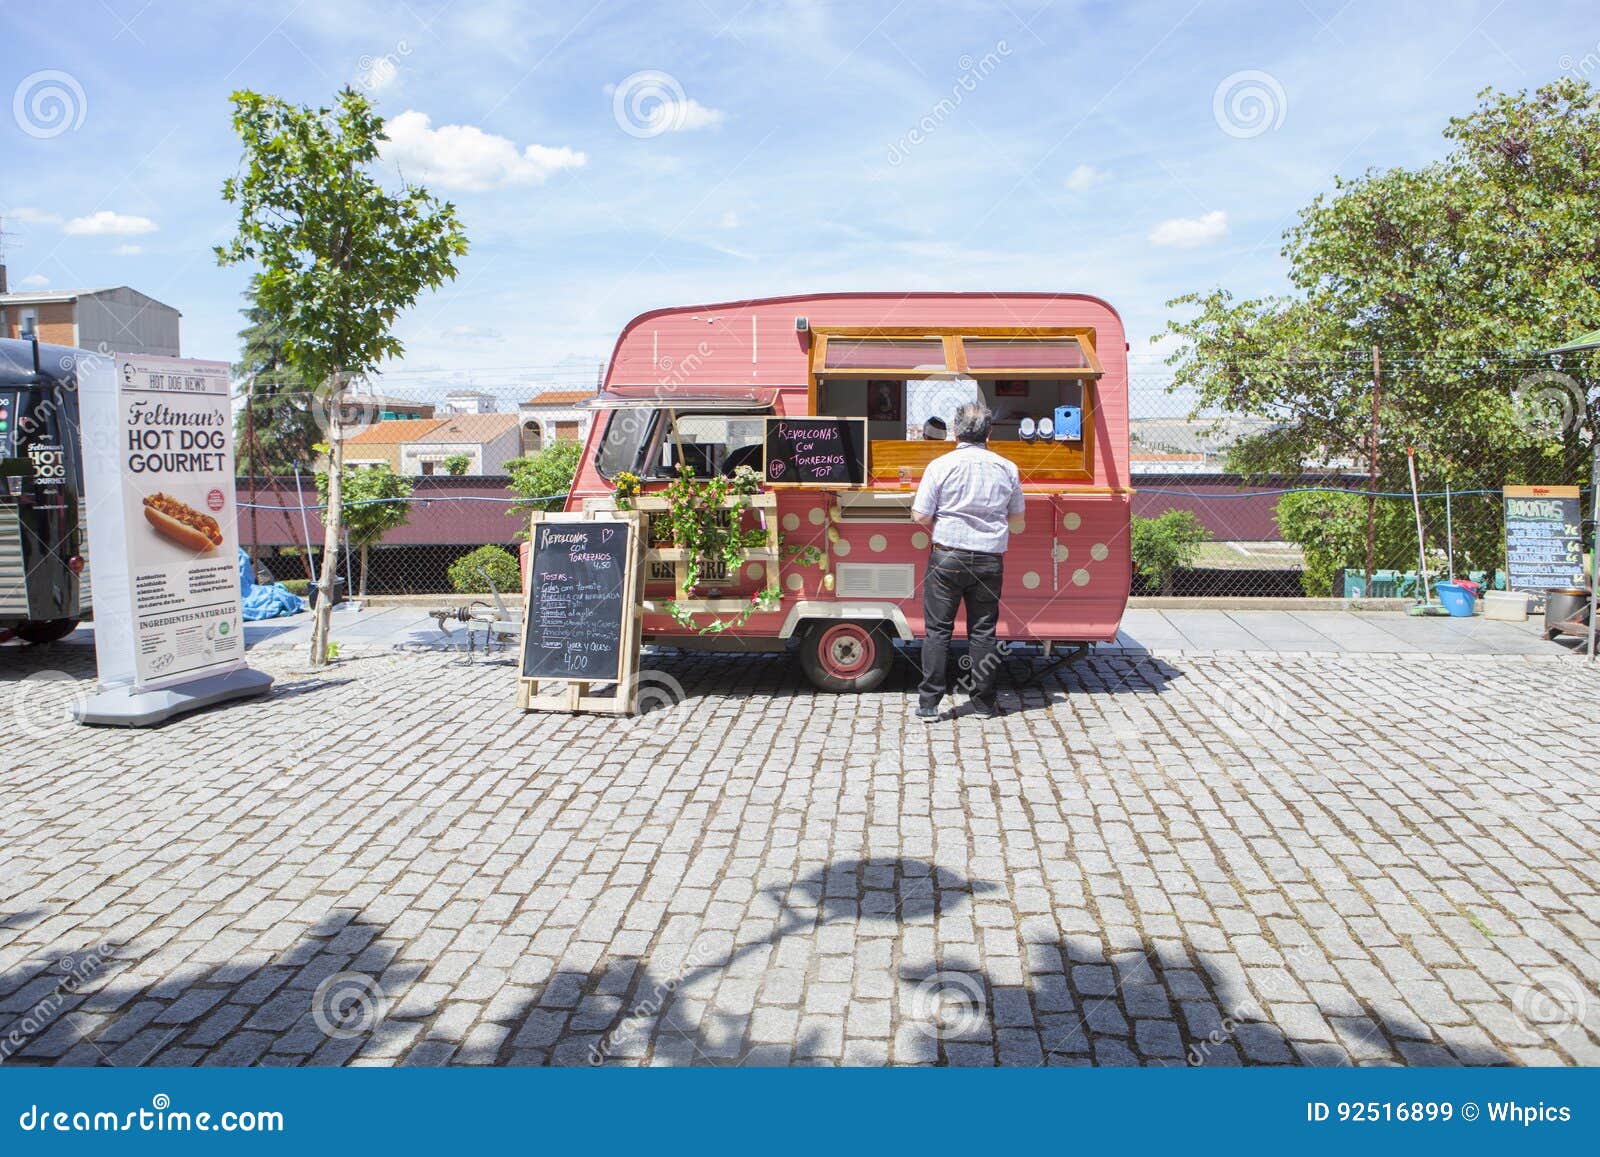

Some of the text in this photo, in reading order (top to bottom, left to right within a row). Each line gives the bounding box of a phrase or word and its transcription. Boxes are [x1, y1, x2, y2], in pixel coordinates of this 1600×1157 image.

[149, 374, 206, 392] HOT DOG NEWS
[128, 400, 224, 427] Feltman's
[128, 429, 226, 450] HOT DOG
[779, 422, 838, 440] REVOLCONAS
[129, 453, 226, 473] GOURMET
[790, 454, 845, 466] TORREZNOS
[811, 466, 832, 478] TOP
[140, 606, 236, 629] INGREDIENTES NATURALES
